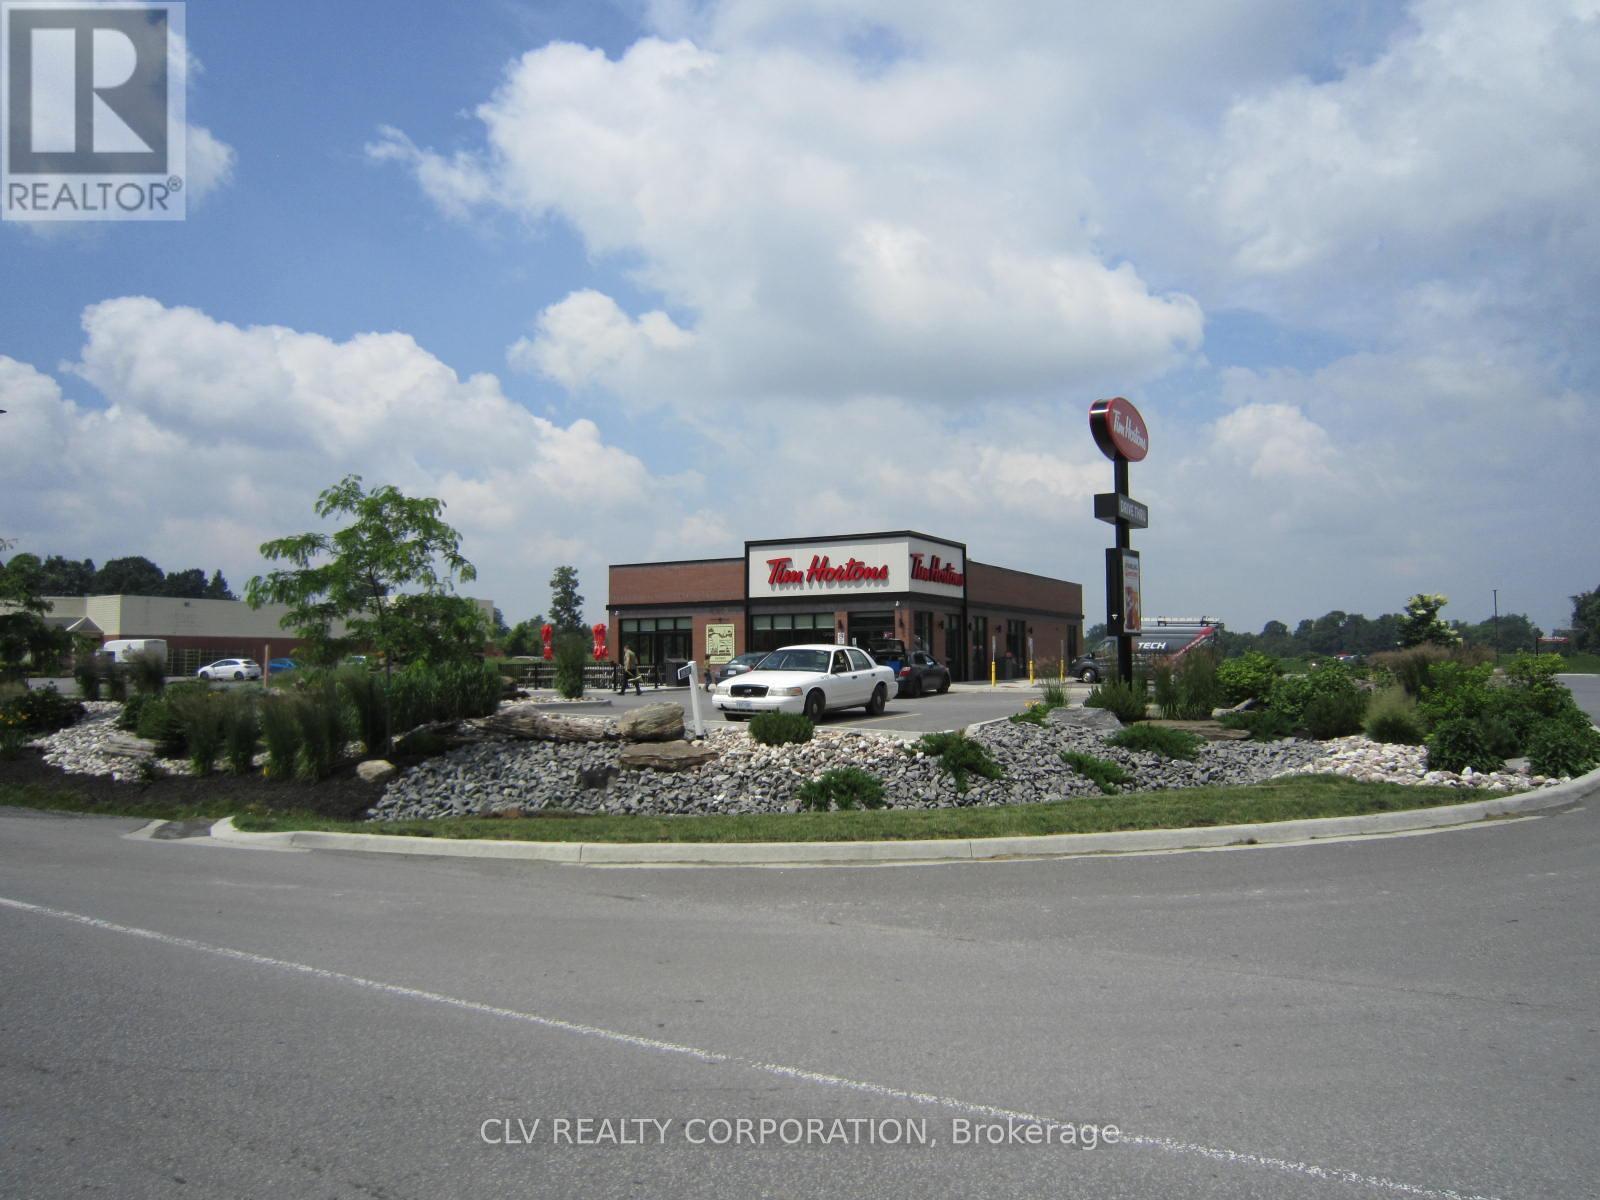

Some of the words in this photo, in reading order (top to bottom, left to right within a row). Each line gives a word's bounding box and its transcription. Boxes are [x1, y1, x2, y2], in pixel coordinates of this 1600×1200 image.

[1112, 408, 1125, 438] Tim
[766, 557, 804, 585] Tim
[806, 555, 889, 583] Hortons
[910, 553, 929, 581] Tim
[1137, 642, 1167, 650] TECH
